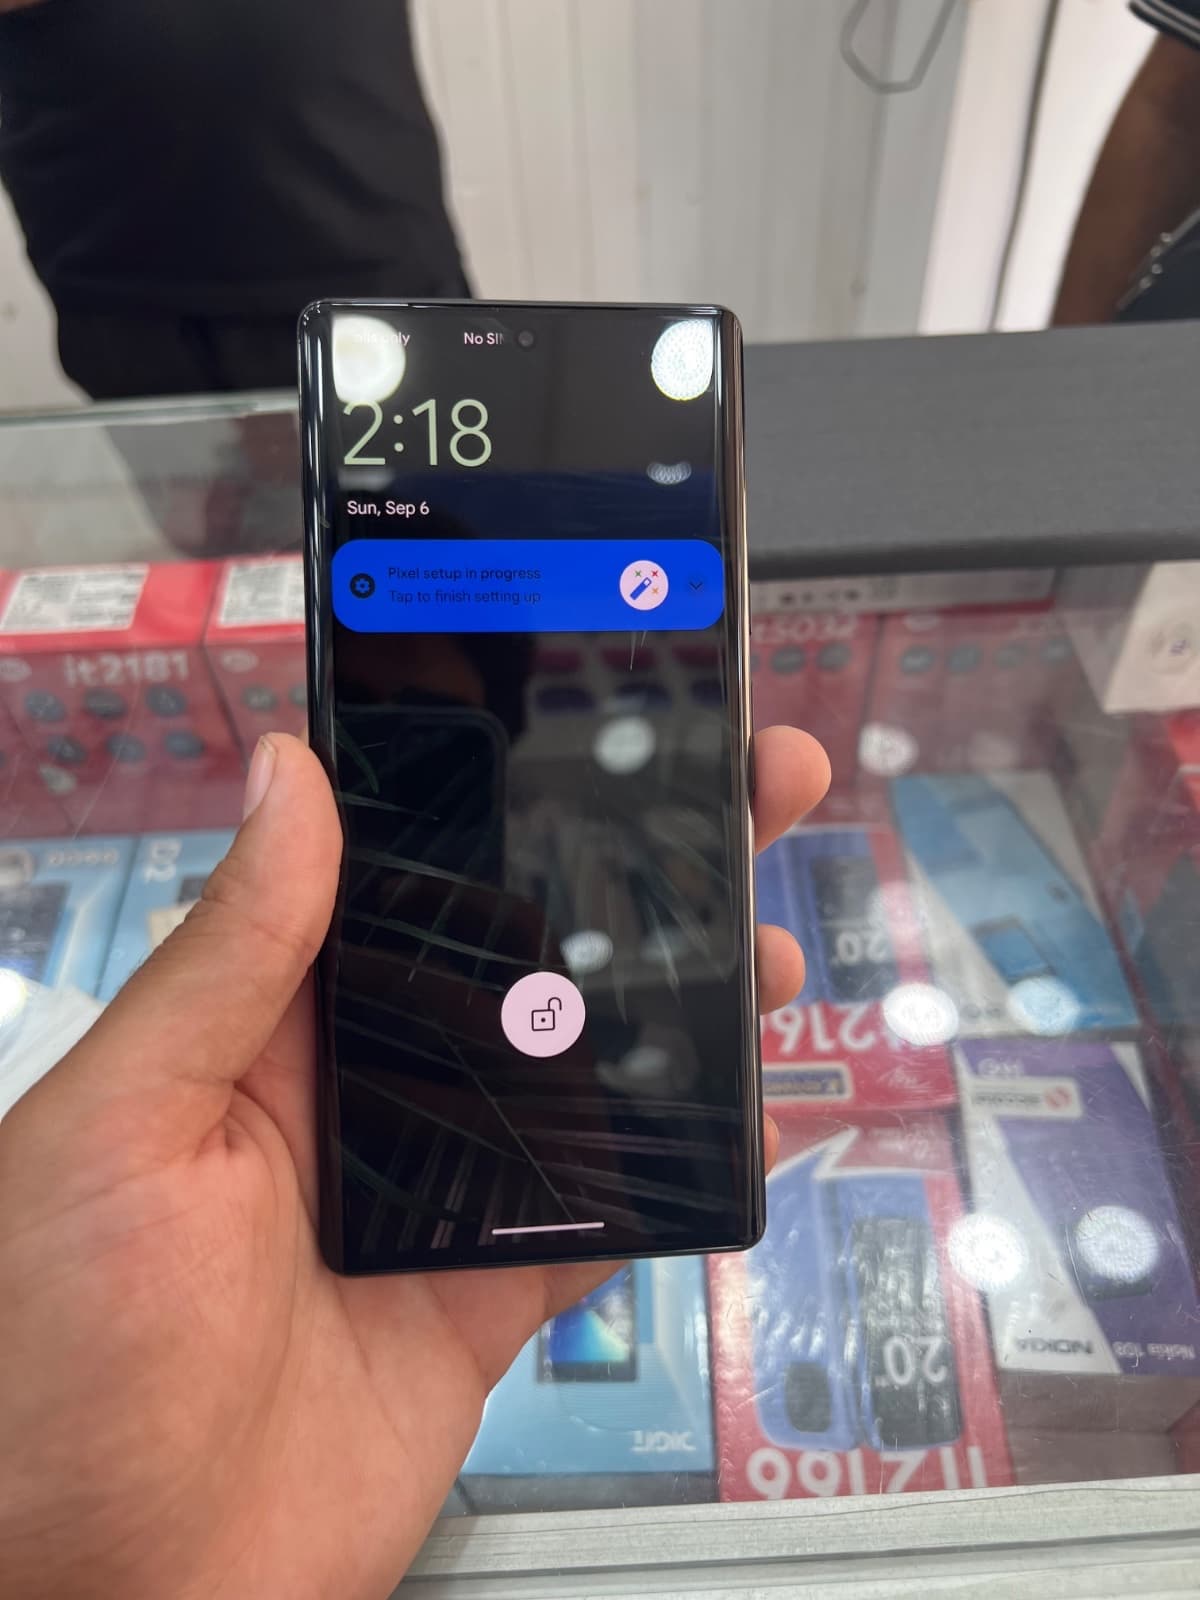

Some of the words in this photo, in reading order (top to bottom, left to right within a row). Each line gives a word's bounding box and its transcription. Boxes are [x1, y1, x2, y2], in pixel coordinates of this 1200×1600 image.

[464, 332, 483, 345] No
[343, 399, 492, 467] 2:18
[347, 500, 381, 516] Sun,
[385, 500, 416, 518] Sep
[420, 501, 430, 515] 6
[388, 567, 419, 580] Pixel
[423, 568, 462, 582] setup
[466, 567, 477, 580] in
[480, 569, 541, 583] progress
[388, 590, 413, 605] Tap
[417, 591, 431, 603] to
[435, 589, 471, 603] finish
[475, 590, 520, 606] setting
[524, 592, 541, 605] up
[63, 651, 190, 687] it2181
